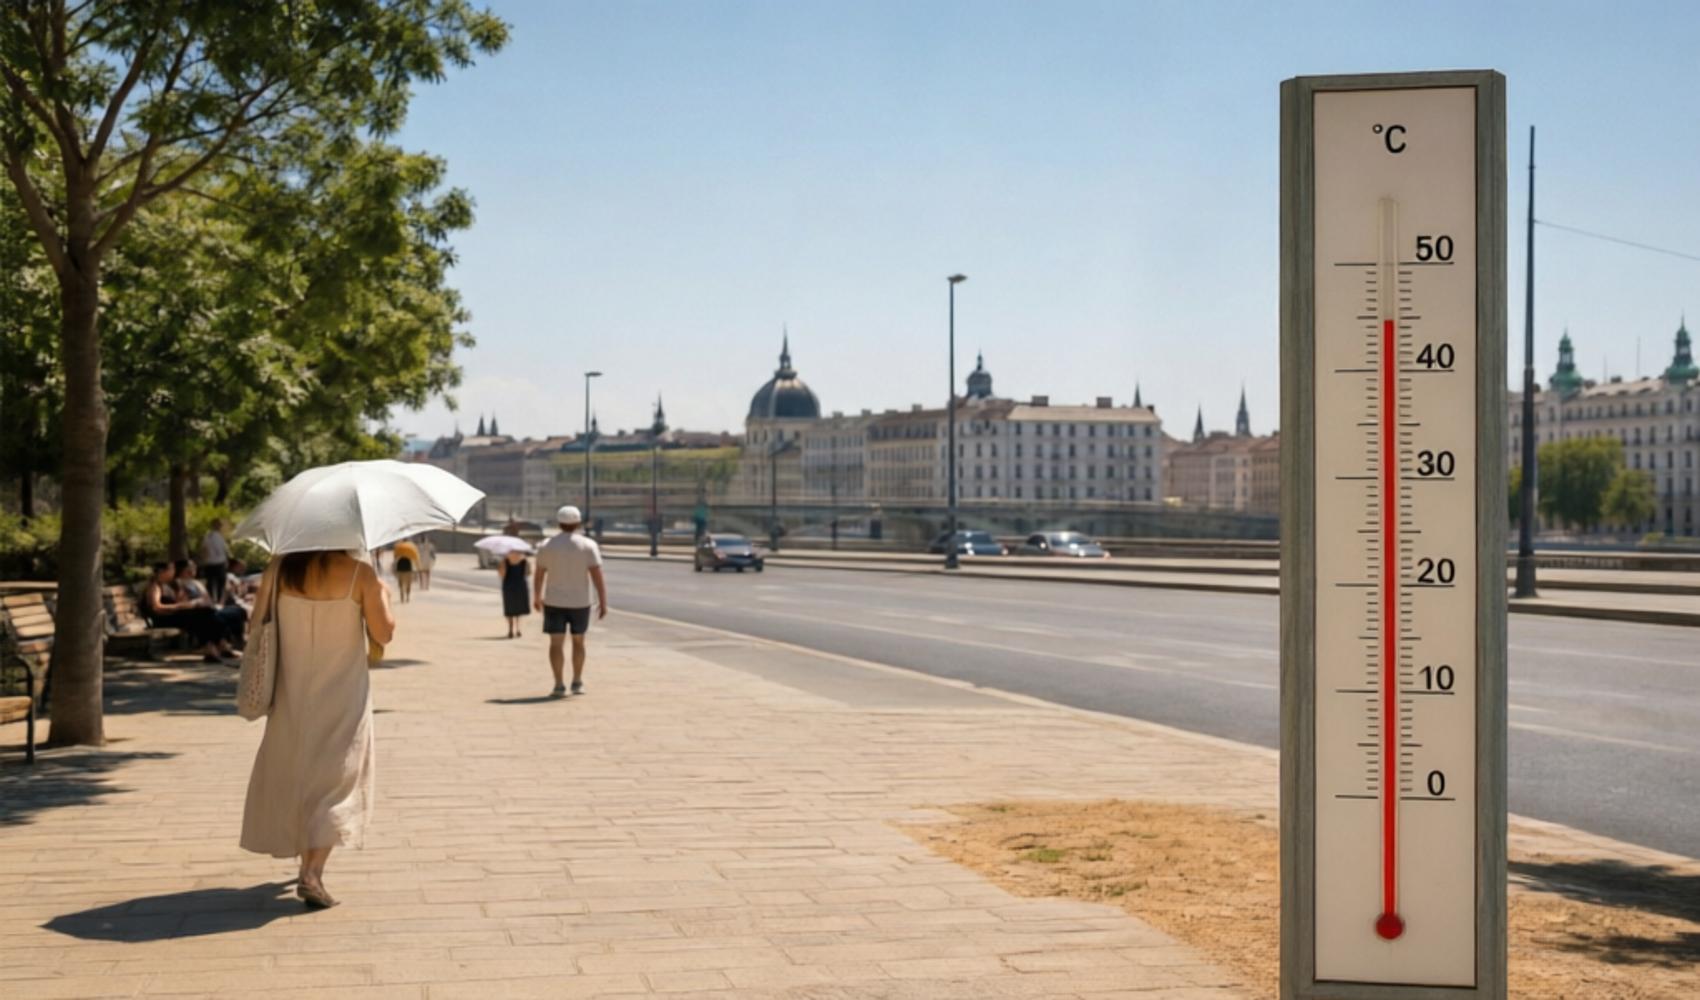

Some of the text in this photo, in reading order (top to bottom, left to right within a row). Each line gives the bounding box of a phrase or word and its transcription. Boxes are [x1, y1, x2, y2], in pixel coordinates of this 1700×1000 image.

[1371, 122, 1407, 154] °C
[1415, 234, 1455, 262] 50
[1416, 342, 1456, 369] 40
[1416, 449, 1456, 476] 30
[1416, 557, 1456, 584] 20
[1419, 665, 1455, 690] 10
[1427, 770, 1446, 796] 0
